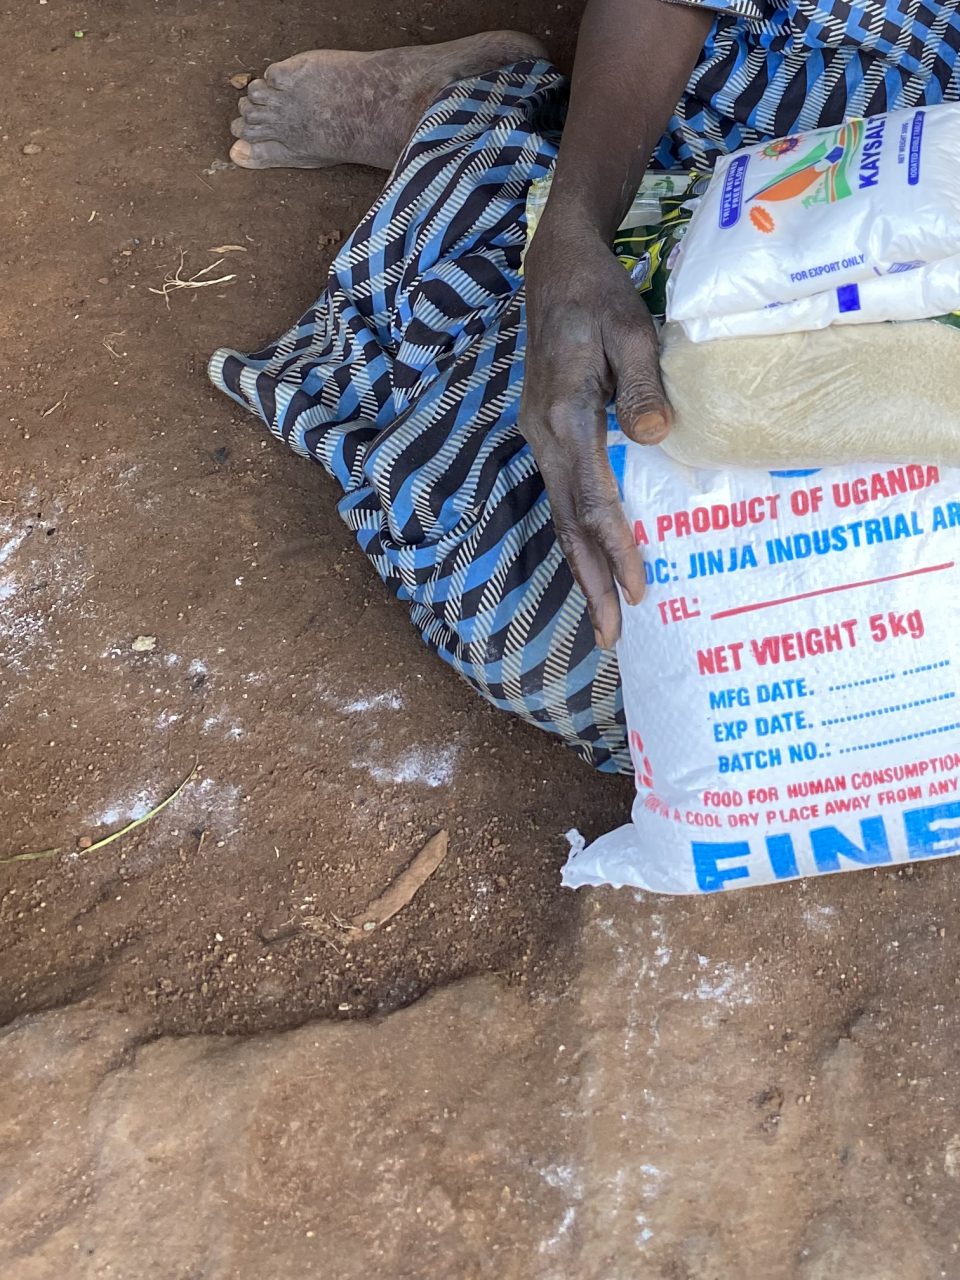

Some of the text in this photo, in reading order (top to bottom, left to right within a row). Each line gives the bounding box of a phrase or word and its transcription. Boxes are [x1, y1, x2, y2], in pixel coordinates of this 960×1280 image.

[722, 161, 739, 223] TRIPLE REFINED
[731, 166, 744, 209] FREE FLOW
[790, 254, 865, 283] FOR EXPORT ONLY
[634, 464, 940, 546] A PRODUCT OF UGANDA
[644, 558, 679, 585] OC:
[688, 544, 758, 579] JINJA
[766, 511, 924, 565] INDUSTRIAL
[656, 596, 701, 625] TEL:
[697, 609, 925, 675] NET WEIGHT 5kg
[709, 678, 815, 710] MFG DATE.
[713, 710, 813, 743] EXP DATE.
[718, 741, 831, 773] BATCH NO.:
[686, 811, 722, 828] COOL
[728, 812, 760, 828] DRY
[825, 794, 872, 816] AWAY
[878, 785, 922, 807] FROM
[928, 776, 959, 797] ANY
[703, 790, 743, 807] FOOD
[748, 786, 779, 805] FOR
[786, 773, 847, 799] HUMAN
